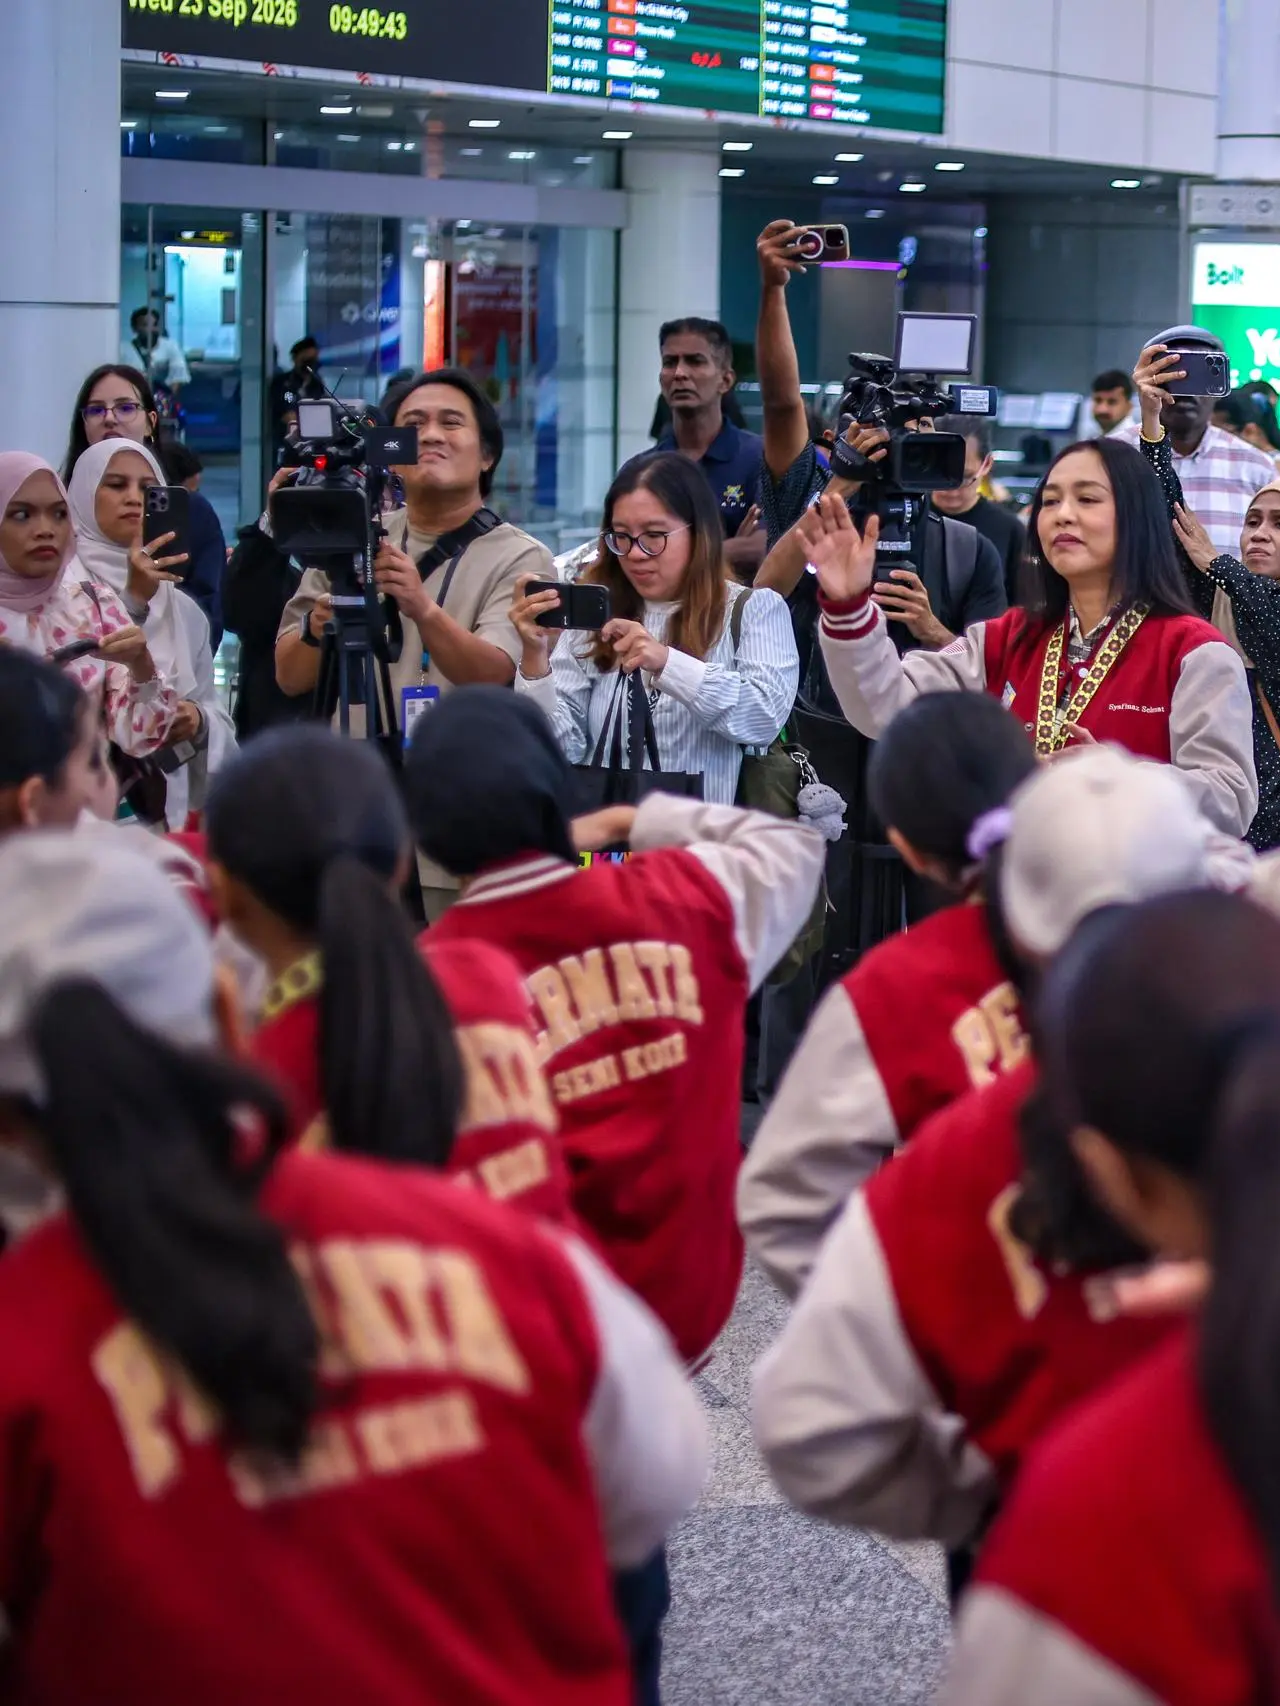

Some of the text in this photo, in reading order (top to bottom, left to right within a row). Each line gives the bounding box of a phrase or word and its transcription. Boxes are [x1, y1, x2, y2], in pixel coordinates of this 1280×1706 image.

[207, 0, 248, 27] Sep
[252, 0, 297, 27] 2026
[329, 4, 407, 40] 09:49:43
[1207, 262, 1245, 286] Bolt
[520, 940, 704, 1068] RMATA
[553, 1055, 622, 1103] SENI
[90, 1236, 533, 1500] PATA
